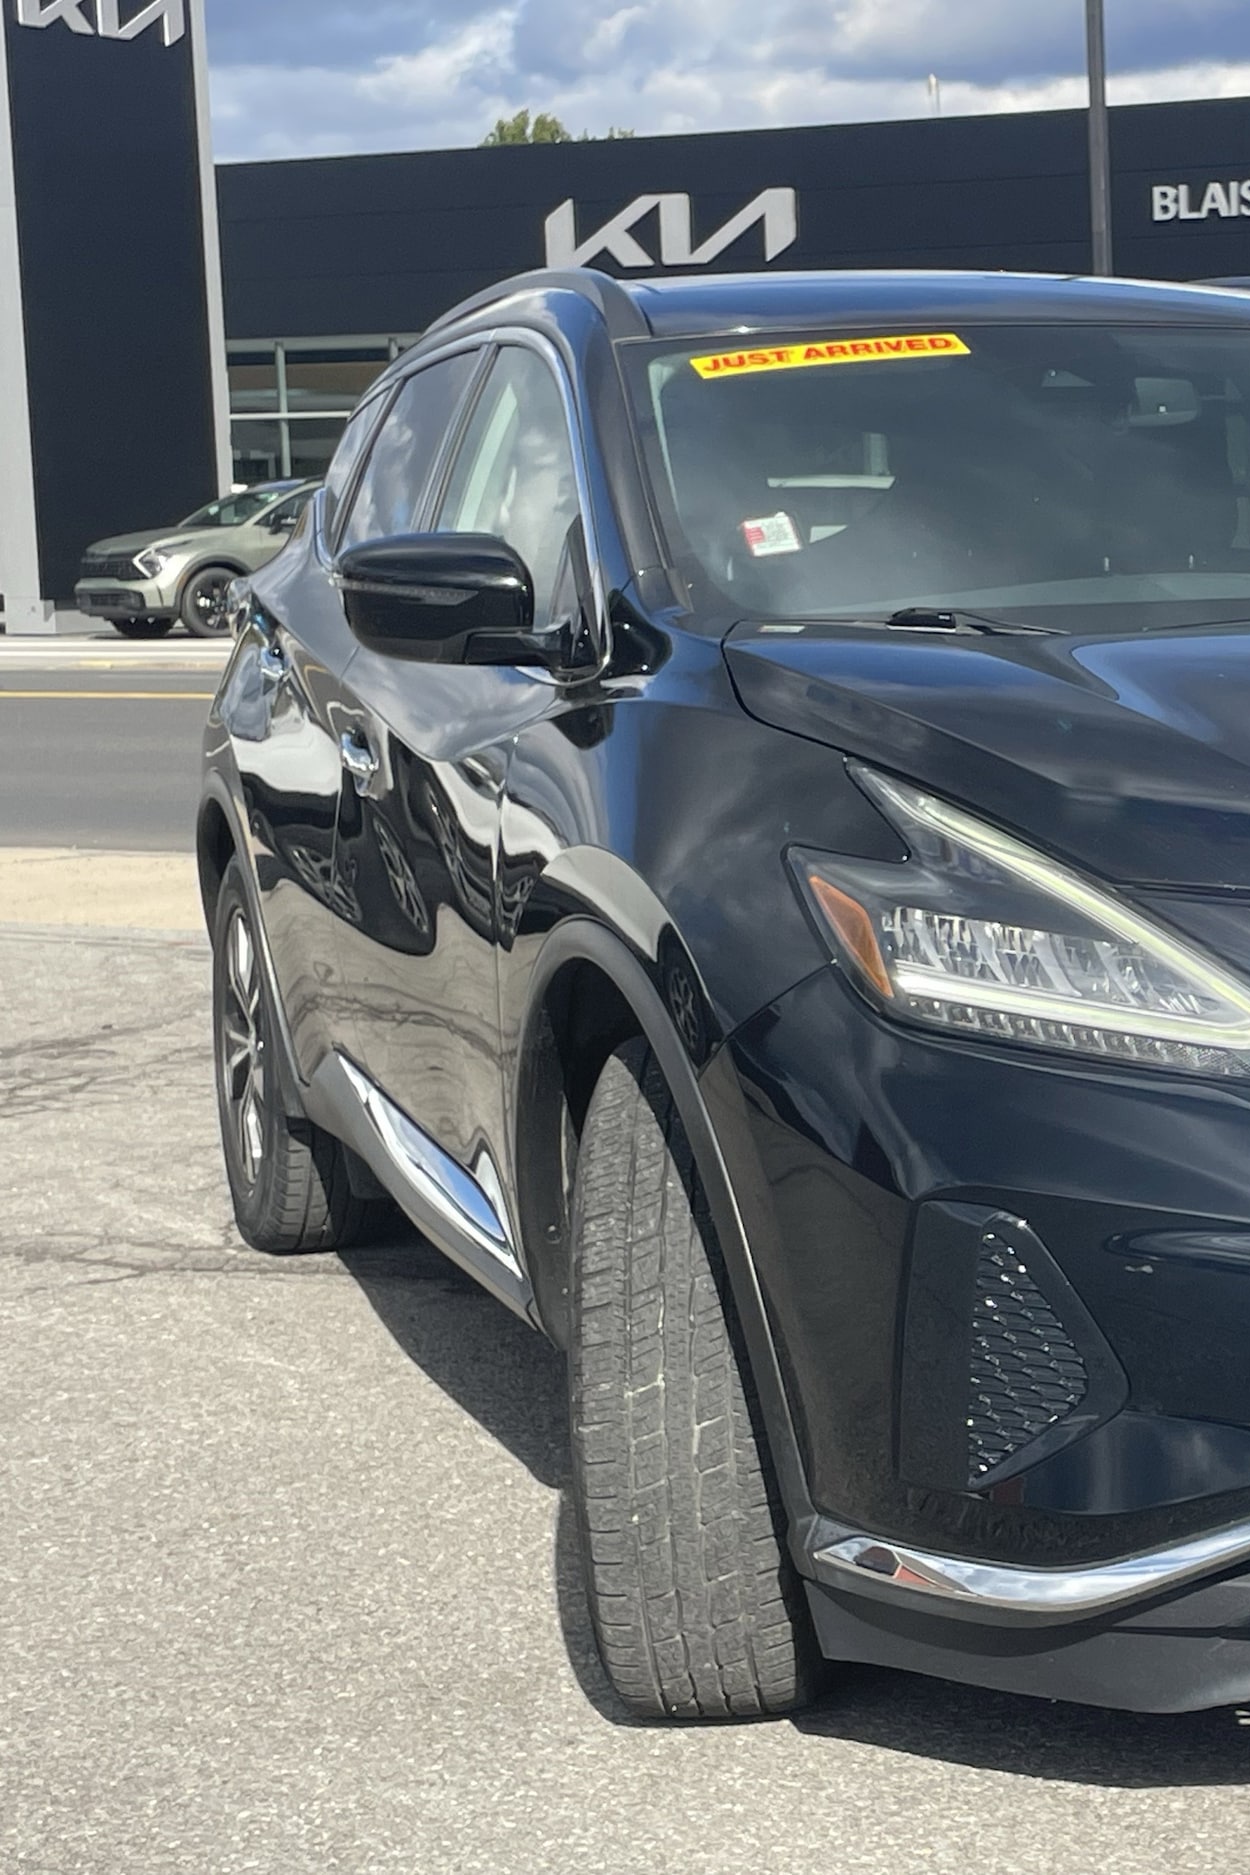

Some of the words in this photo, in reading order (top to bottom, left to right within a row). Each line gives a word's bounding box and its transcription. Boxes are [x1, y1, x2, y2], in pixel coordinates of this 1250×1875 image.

[545, 187, 797, 268] KIA
[703, 350, 789, 372] JUST
[803, 337, 956, 360] ARRIVED
